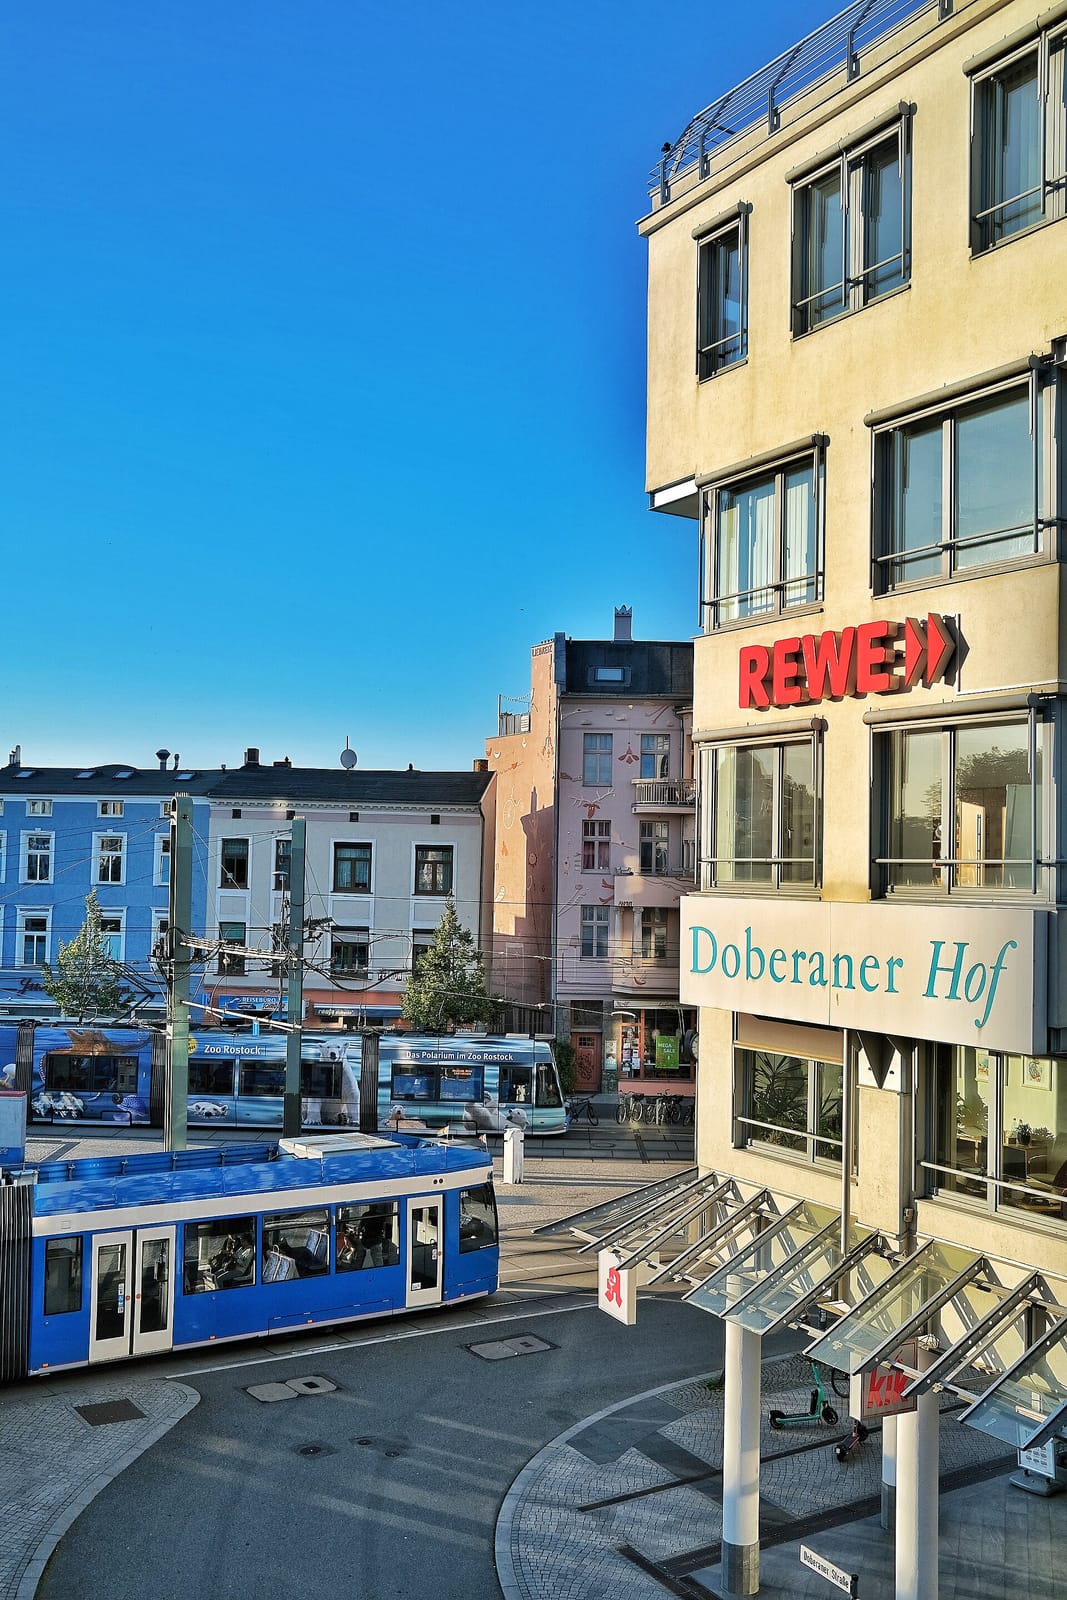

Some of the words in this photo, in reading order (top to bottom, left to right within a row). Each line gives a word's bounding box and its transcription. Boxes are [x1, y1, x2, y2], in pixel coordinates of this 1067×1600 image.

[739, 619, 891, 709] REWE
[688, 926, 904, 993] Doberaner
[922, 940, 1018, 1029] Hof
[204, 1044, 221, 1053] Zoo
[223, 1045, 261, 1055] Rostock
[406, 1051, 420, 1059] Das
[421, 1051, 455, 1060] Polarium
[456, 1051, 466, 1060] im
[467, 1052, 482, 1060] Zoo
[483, 1052, 514, 1061] Rostock
[803, 1550, 829, 1575] Doberaner
[831, 1569, 849, 1588] Straße
